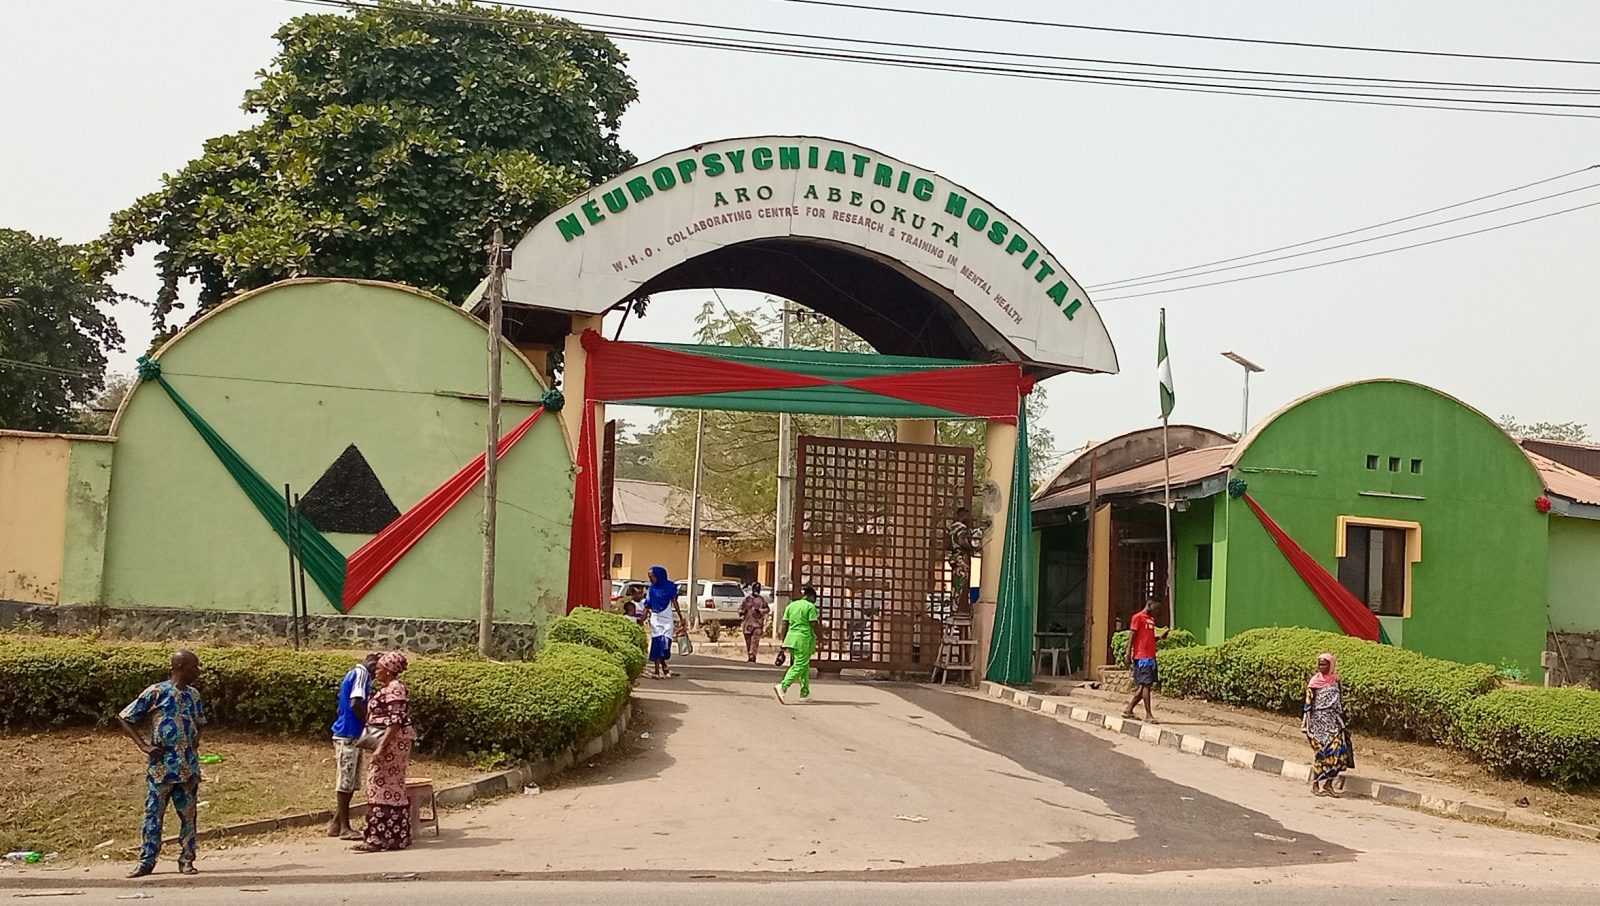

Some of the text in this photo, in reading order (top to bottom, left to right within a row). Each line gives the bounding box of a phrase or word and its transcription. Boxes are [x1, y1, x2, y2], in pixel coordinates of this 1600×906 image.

[555, 146, 1082, 321] NEUROPSYCHIATRIC HOSPITAL
[667, 209, 752, 246] COLLABORATING
[758, 205, 799, 219] CENTRE
[806, 206, 825, 219] FOR
[832, 210, 884, 233] RESEARCH
[888, 227, 896, 237] &
[900, 231, 945, 260] TRAINING
[947, 254, 958, 267] IN
[960, 265, 992, 296] MENTAL
[994, 292, 1023, 325] HEALTH
[713, 185, 960, 248] ARO ABEOKUTA
